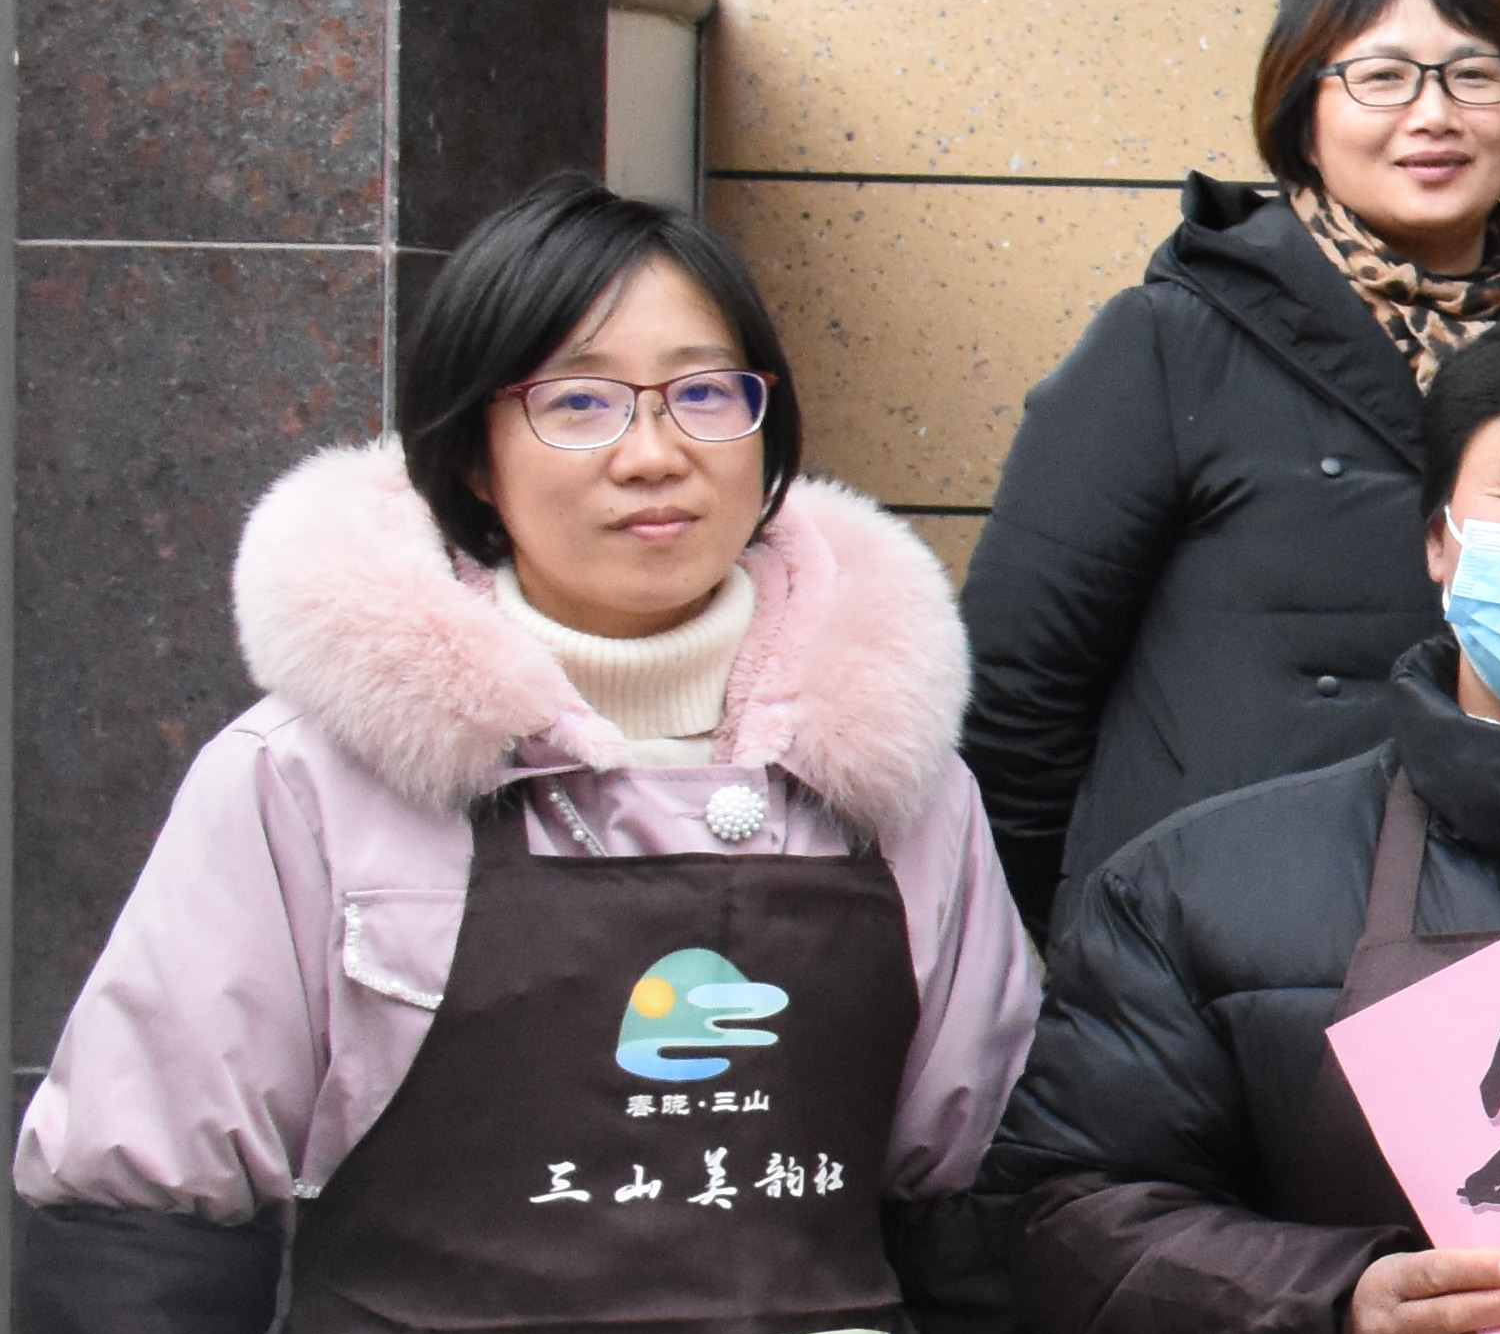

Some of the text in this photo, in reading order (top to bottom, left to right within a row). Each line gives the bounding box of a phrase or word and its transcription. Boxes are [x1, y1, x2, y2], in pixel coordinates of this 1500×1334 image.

[528, 1146, 845, 1210] 三山美韵社
